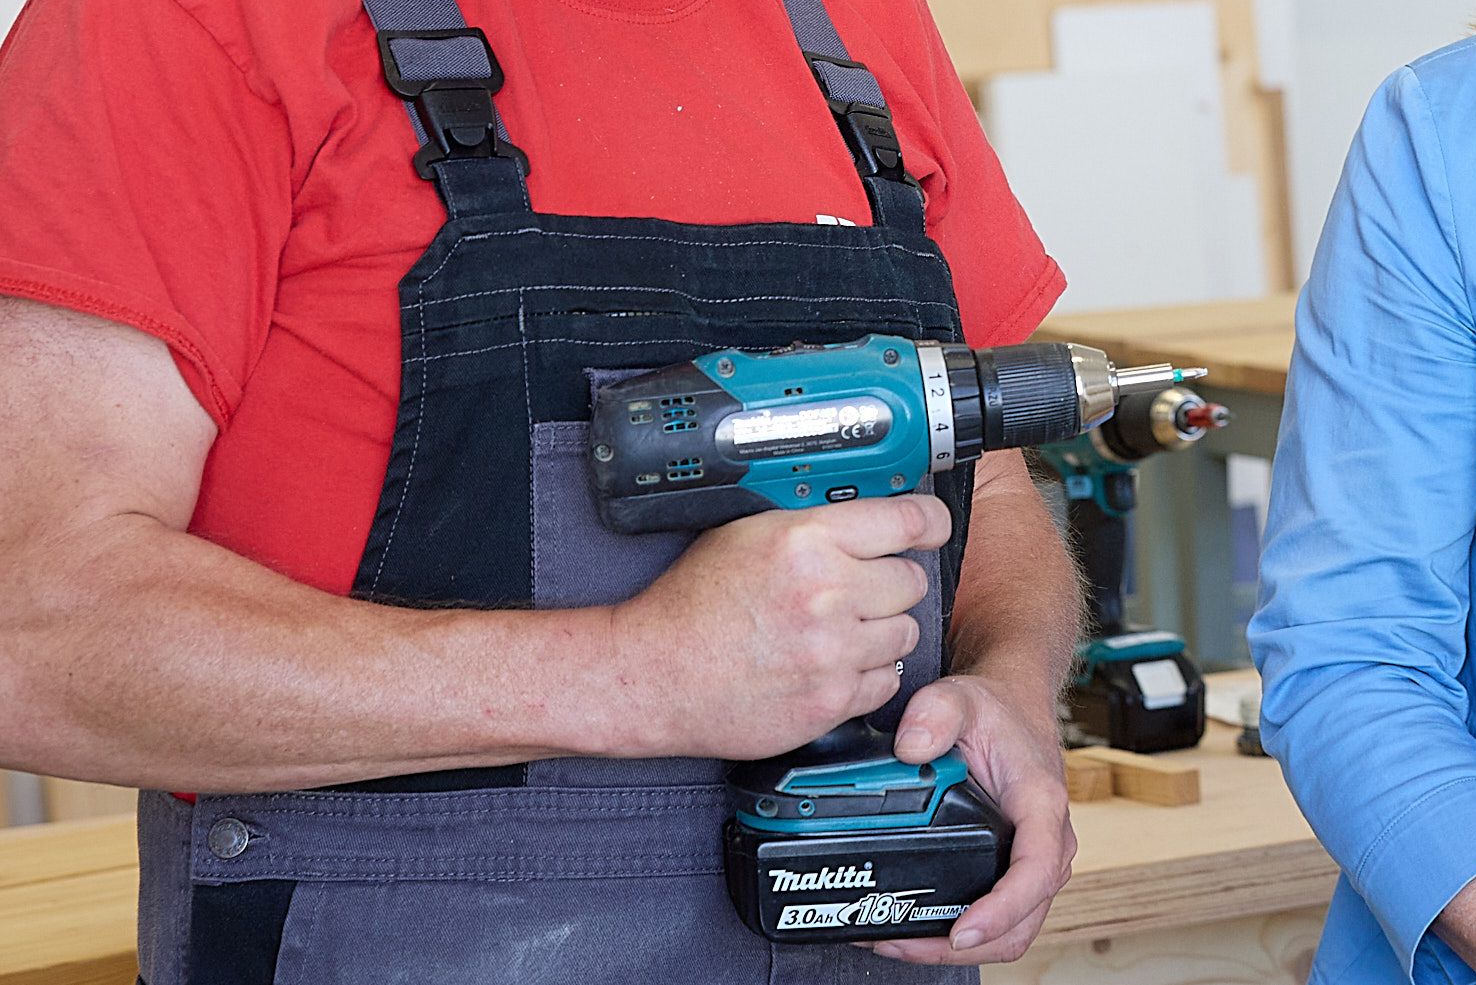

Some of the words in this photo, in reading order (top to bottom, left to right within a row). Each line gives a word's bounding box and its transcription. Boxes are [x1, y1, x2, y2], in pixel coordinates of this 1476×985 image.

[931, 388, 945, 397] 2
[935, 422, 949, 432] 4
[936, 451, 950, 460] 6
[784, 908, 833, 926] 3.0Ah
[855, 892, 916, 926] 18V
